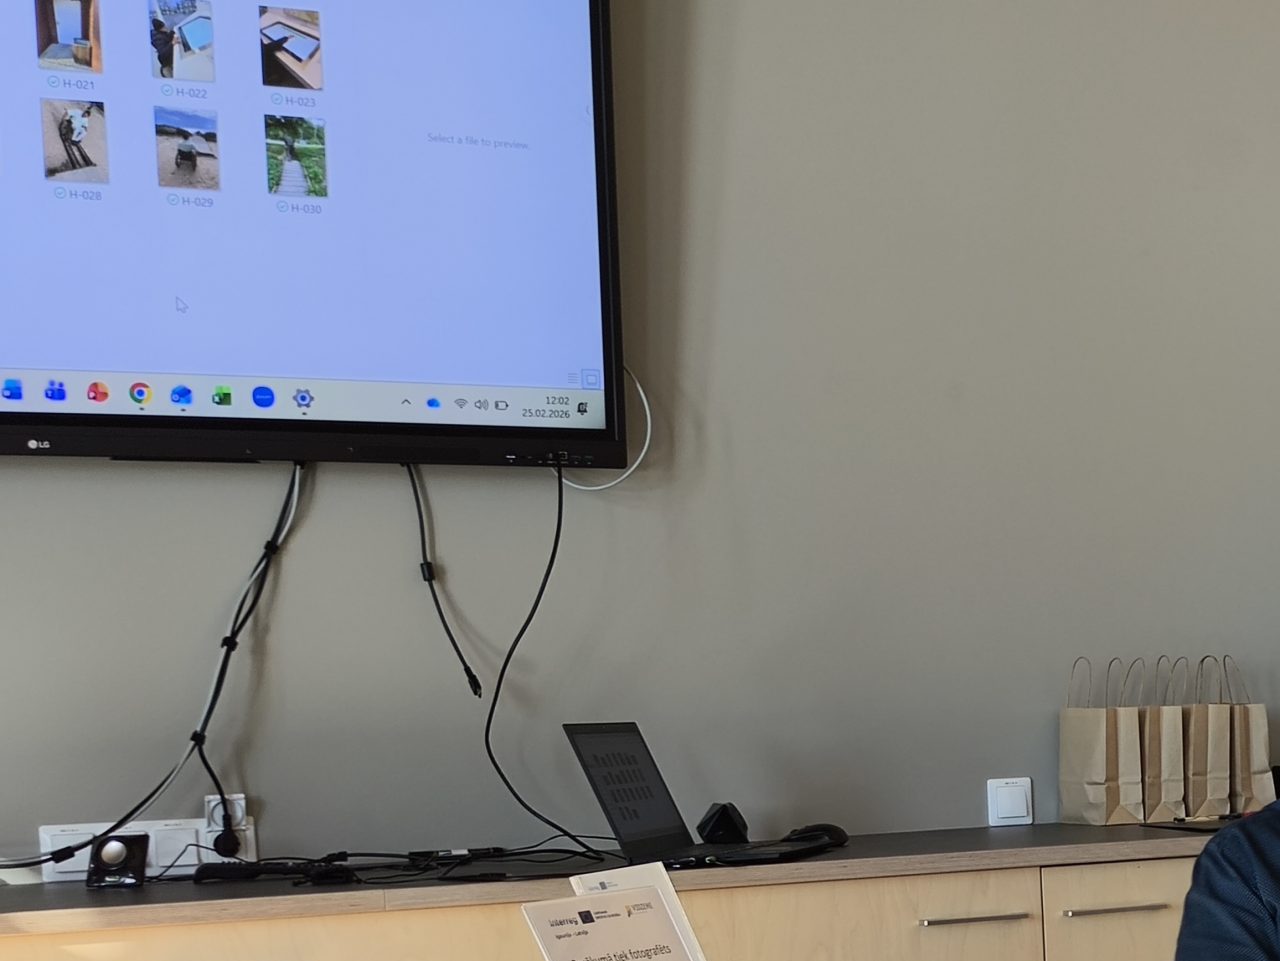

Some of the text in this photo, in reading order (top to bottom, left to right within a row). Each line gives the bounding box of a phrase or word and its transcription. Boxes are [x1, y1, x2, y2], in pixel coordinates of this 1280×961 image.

[62, 78, 95, 90] H-021
[175, 88, 208, 99] H-022
[285, 96, 316, 107] H-023
[427, 132, 454, 144] Select
[465, 135, 479, 146] file
[481, 138, 491, 146] to
[69, 189, 102, 201] H-028
[181, 196, 214, 207] H-029
[290, 203, 322, 214] H-030
[546, 396, 570, 406] 12:02
[522, 408, 571, 418] 25.02.2026
[39, 440, 50, 449] LG
[613, 950, 629, 961] tiek
[629, 944, 672, 960] fotografēts
